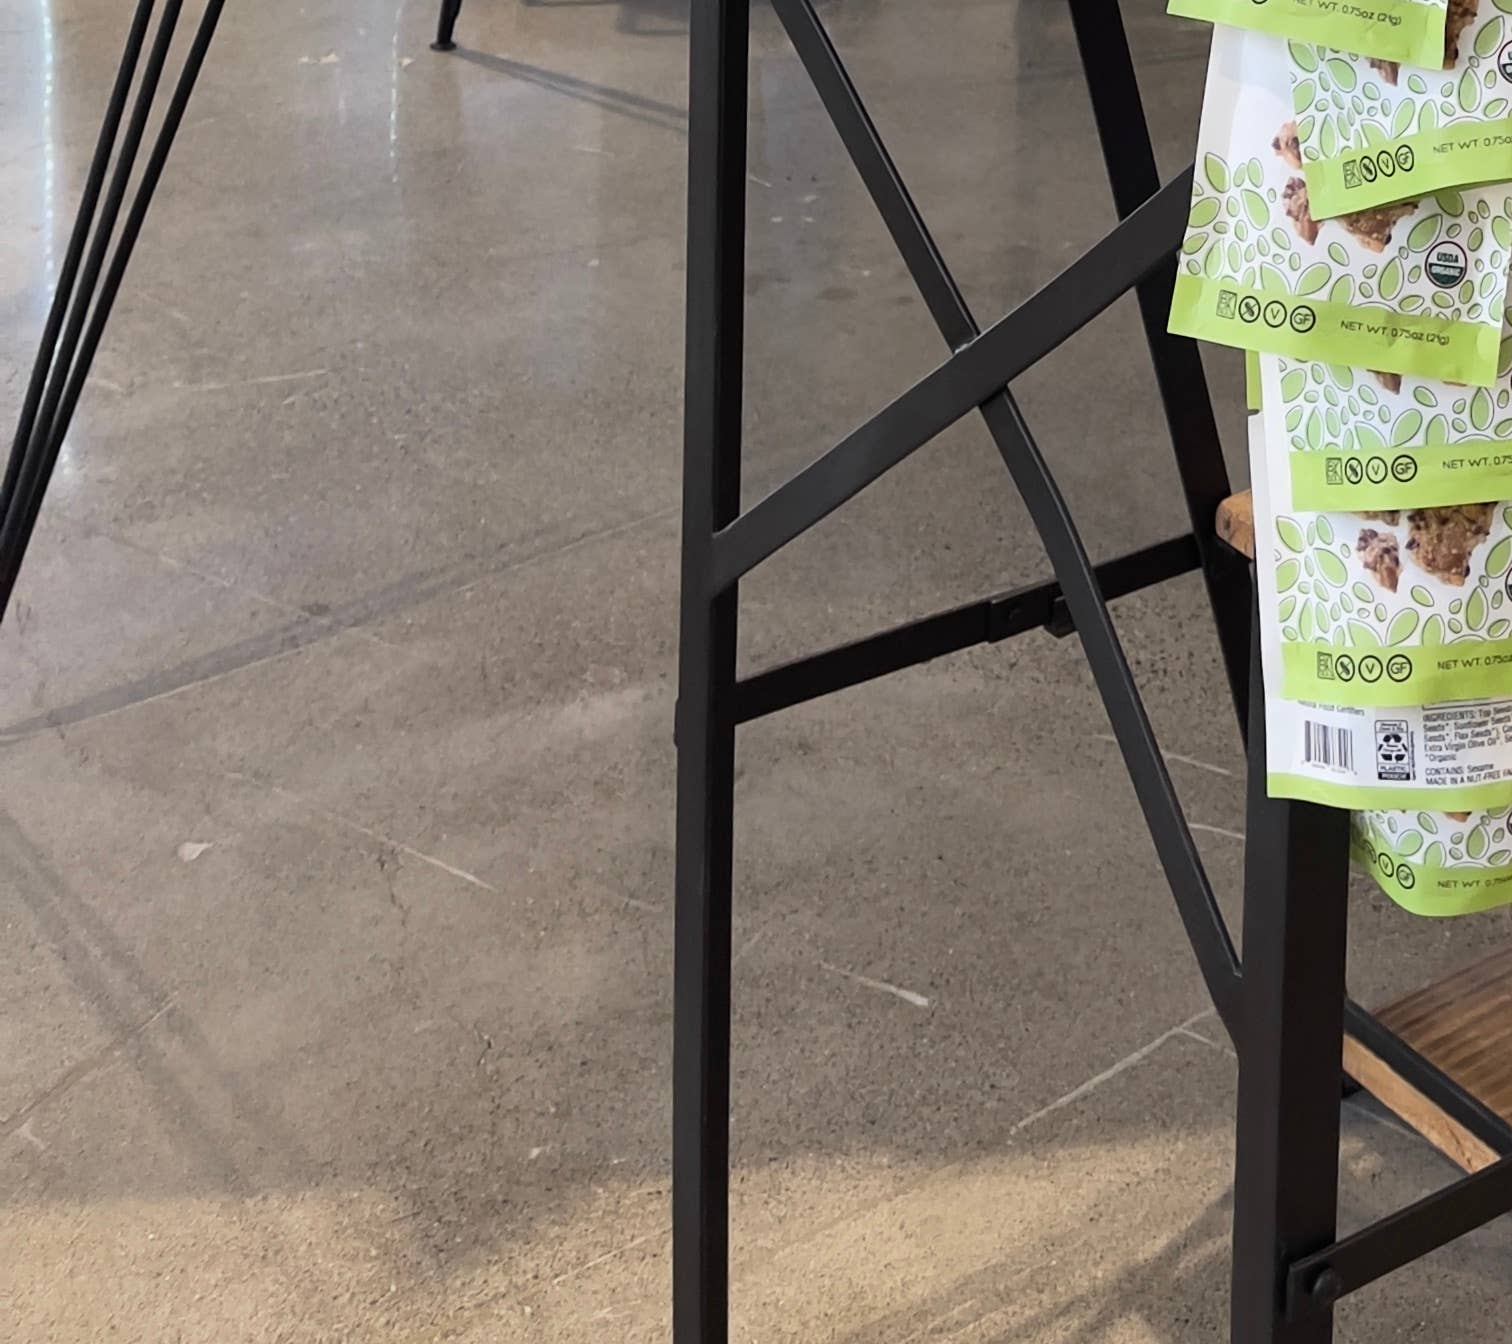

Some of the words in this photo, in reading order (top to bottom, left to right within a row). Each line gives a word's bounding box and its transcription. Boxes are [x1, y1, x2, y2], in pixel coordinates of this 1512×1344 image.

[1432, 142, 1456, 156] NET
[1436, 252, 1460, 265] USDA
[1340, 318, 1363, 332] NET
[1442, 458, 1465, 470] NET
